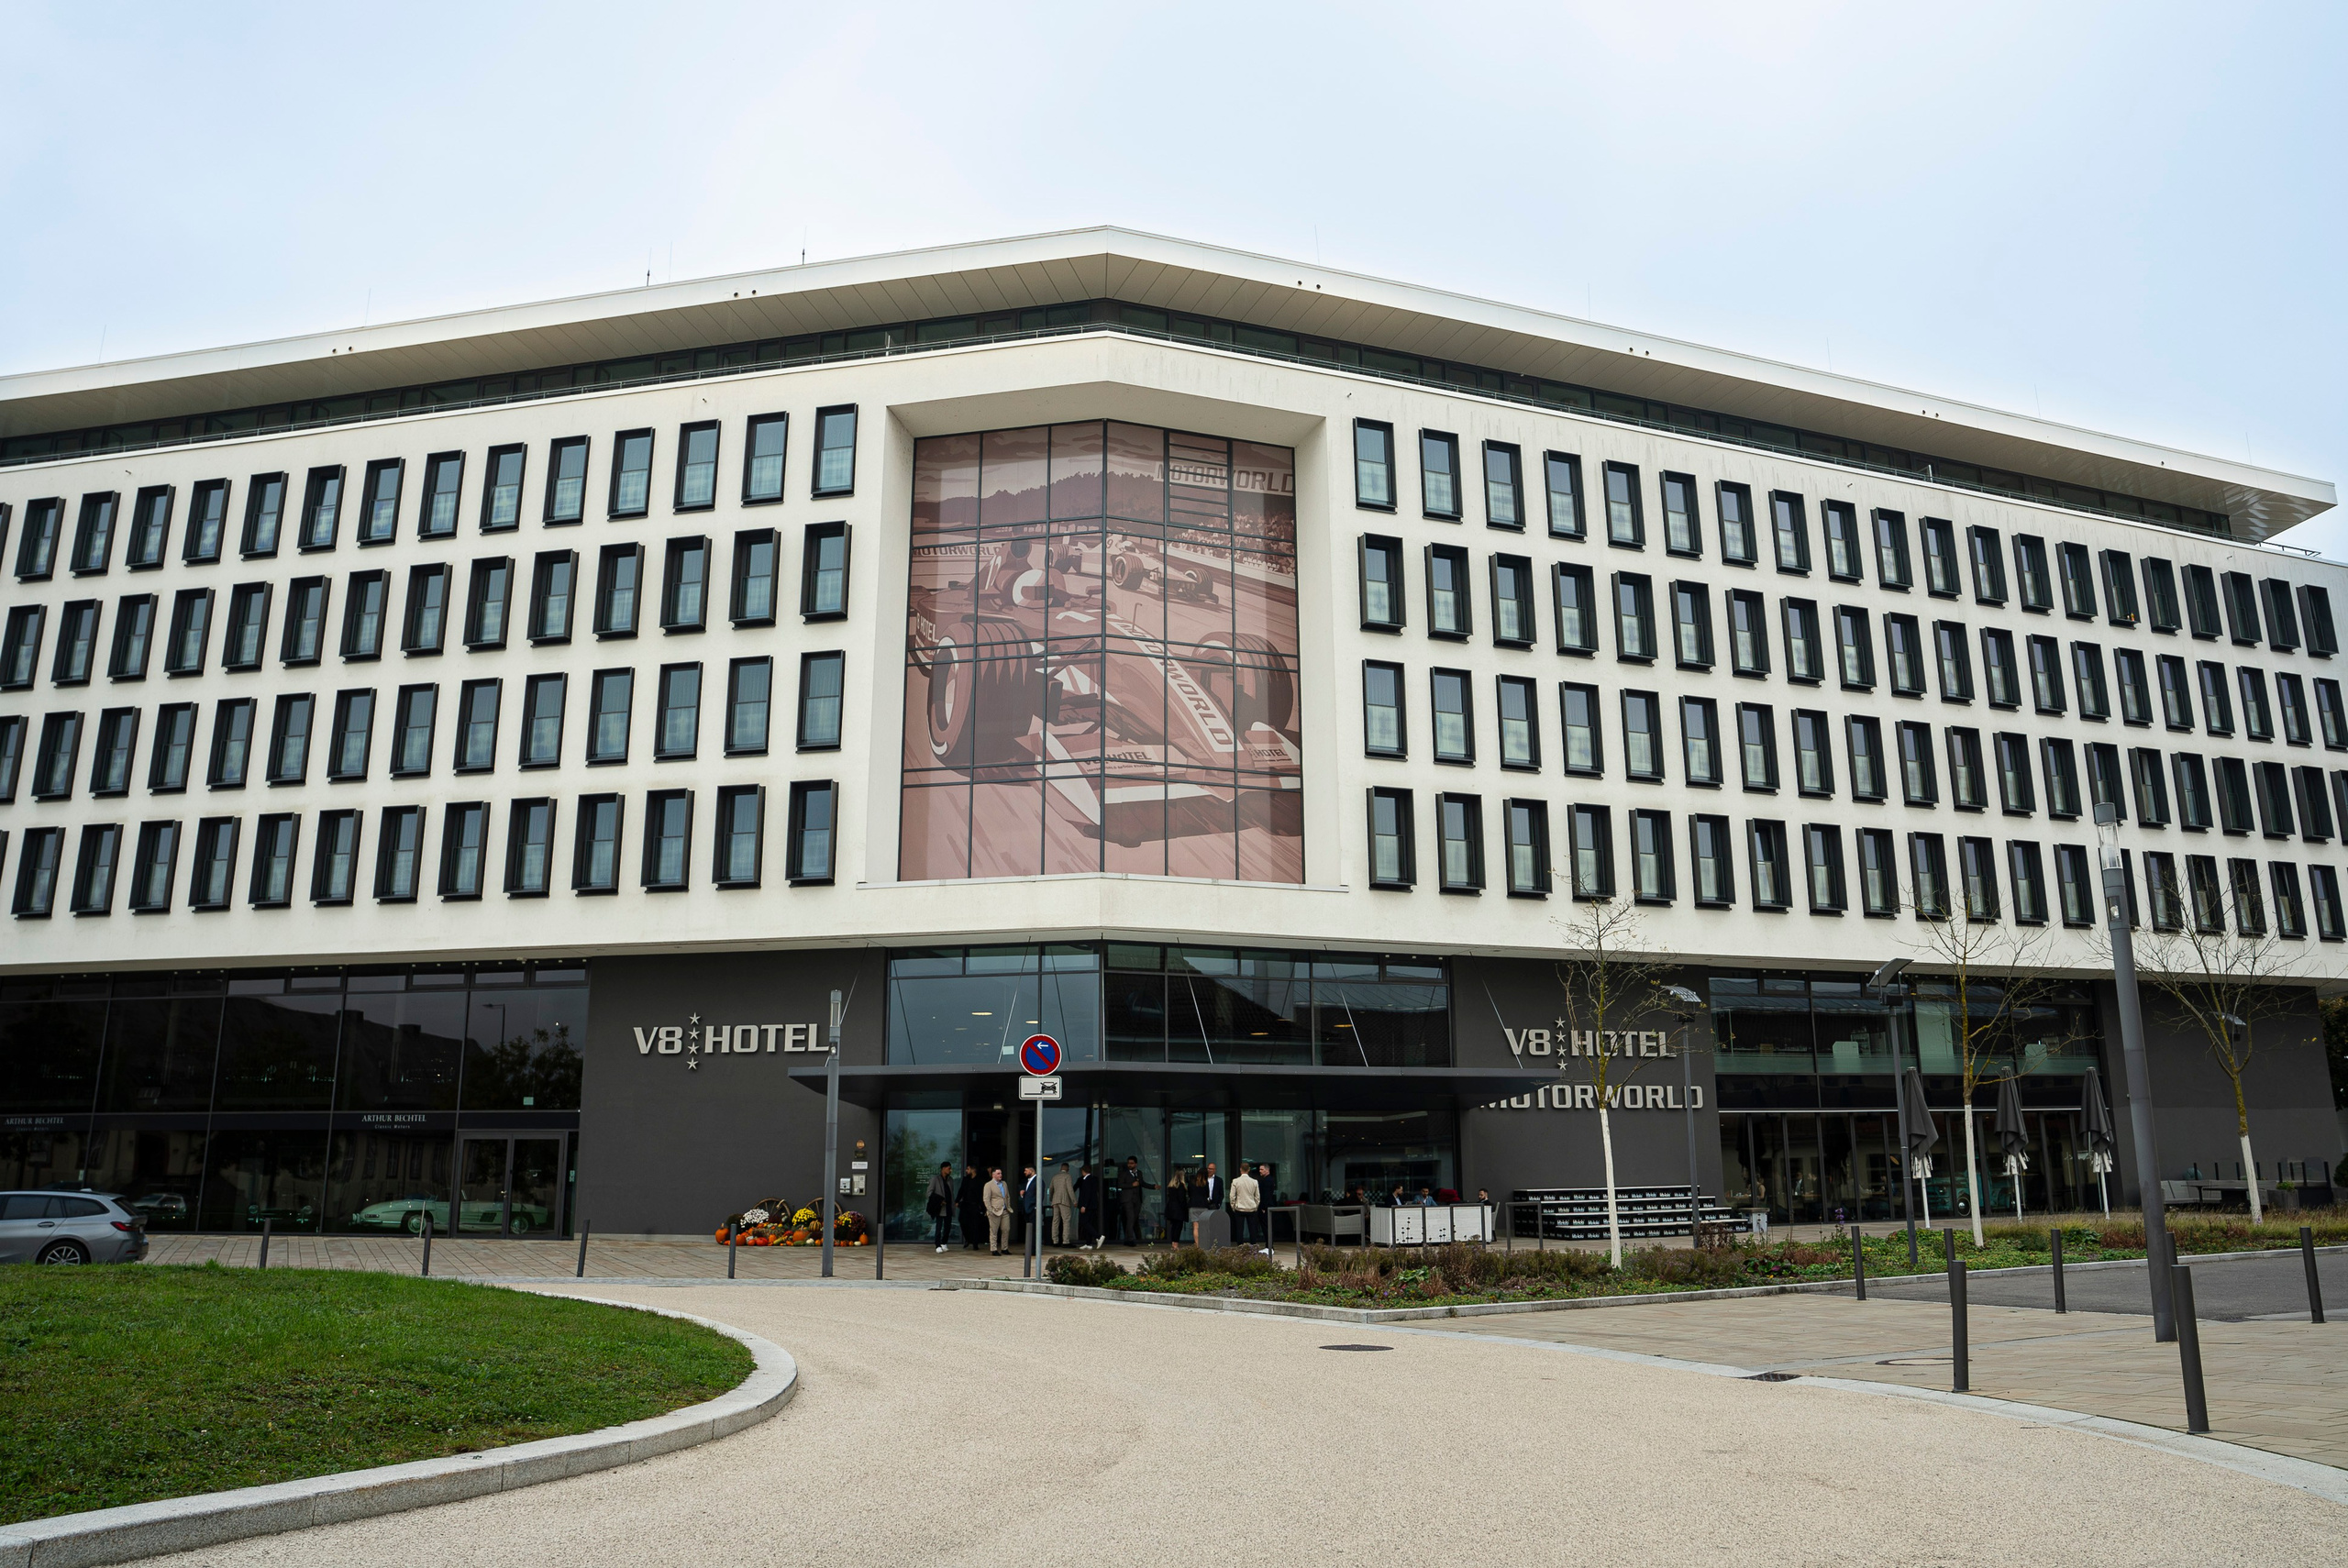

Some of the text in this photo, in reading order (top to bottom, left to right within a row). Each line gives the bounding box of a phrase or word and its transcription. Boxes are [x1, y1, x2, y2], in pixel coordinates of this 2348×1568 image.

[1119, 624, 1234, 745] MOORWORLD
[633, 1023, 829, 1055] V8 HOTEL
[1505, 1028, 1677, 1057] V8 HOTEL
[5, 1117, 32, 1125] ARTHUR
[361, 1114, 426, 1122] ARTHUR BECHTEL
